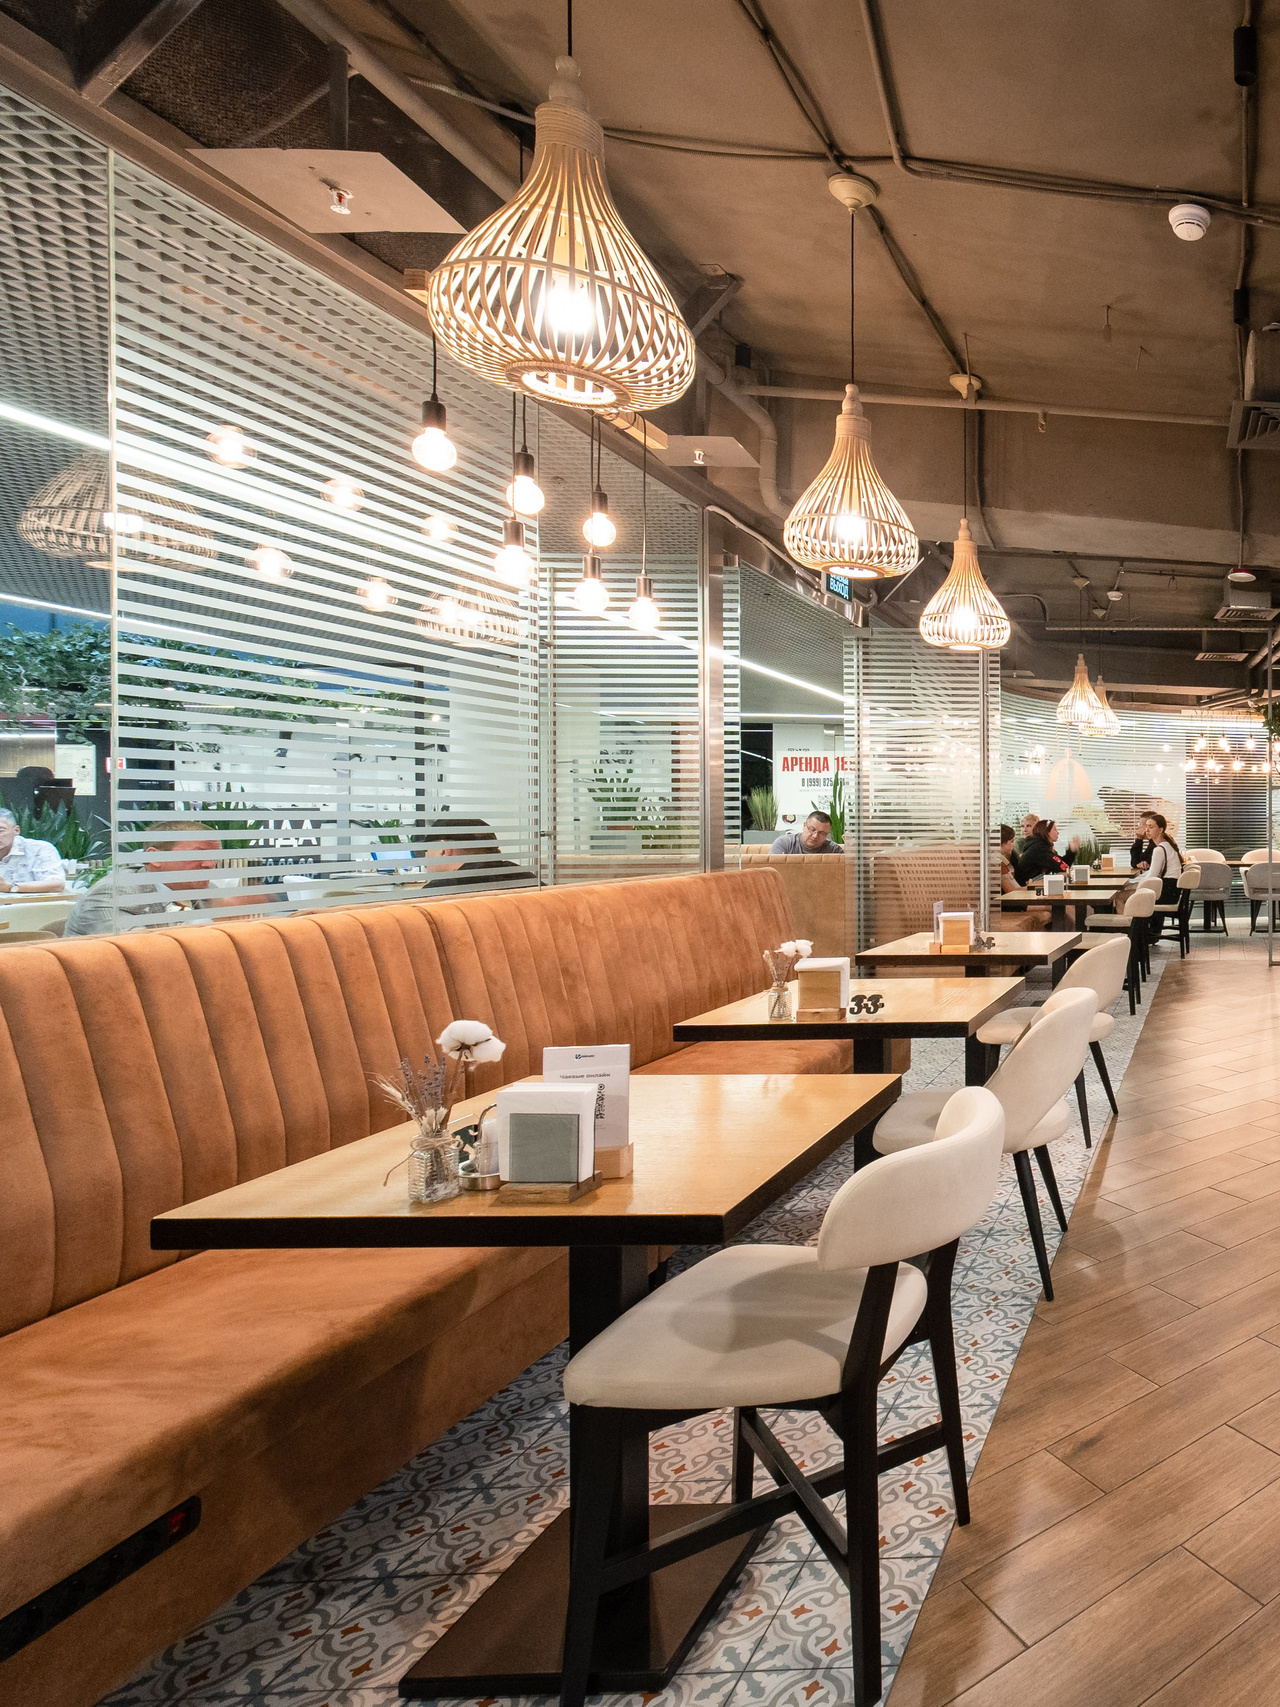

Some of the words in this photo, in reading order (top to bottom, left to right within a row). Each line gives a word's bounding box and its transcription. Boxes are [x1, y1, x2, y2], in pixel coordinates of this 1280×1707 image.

[782, 757, 829, 773] АРЕНДА
[801, 778, 806, 787] 8
[807, 778, 821, 787] (999)
